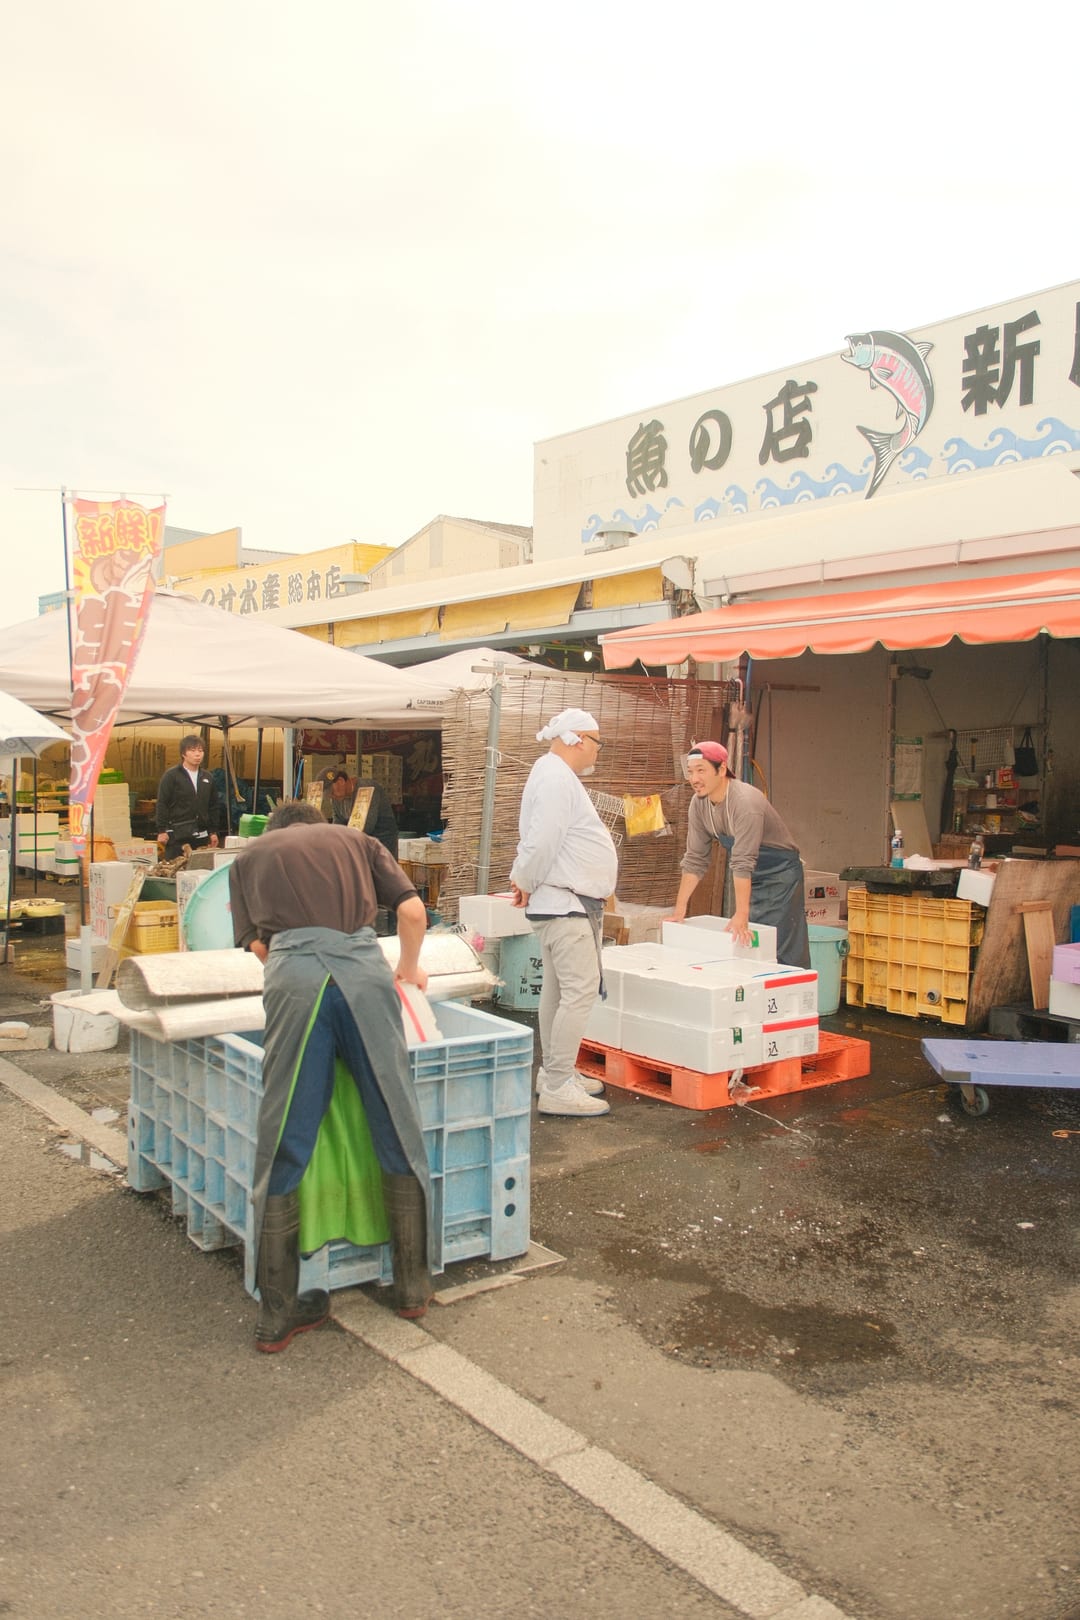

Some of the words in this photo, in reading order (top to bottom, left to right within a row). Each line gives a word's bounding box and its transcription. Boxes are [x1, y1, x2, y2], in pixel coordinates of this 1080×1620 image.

[625, 379, 818, 498] 魚の店
[961, 301, 1080, 416] 新
